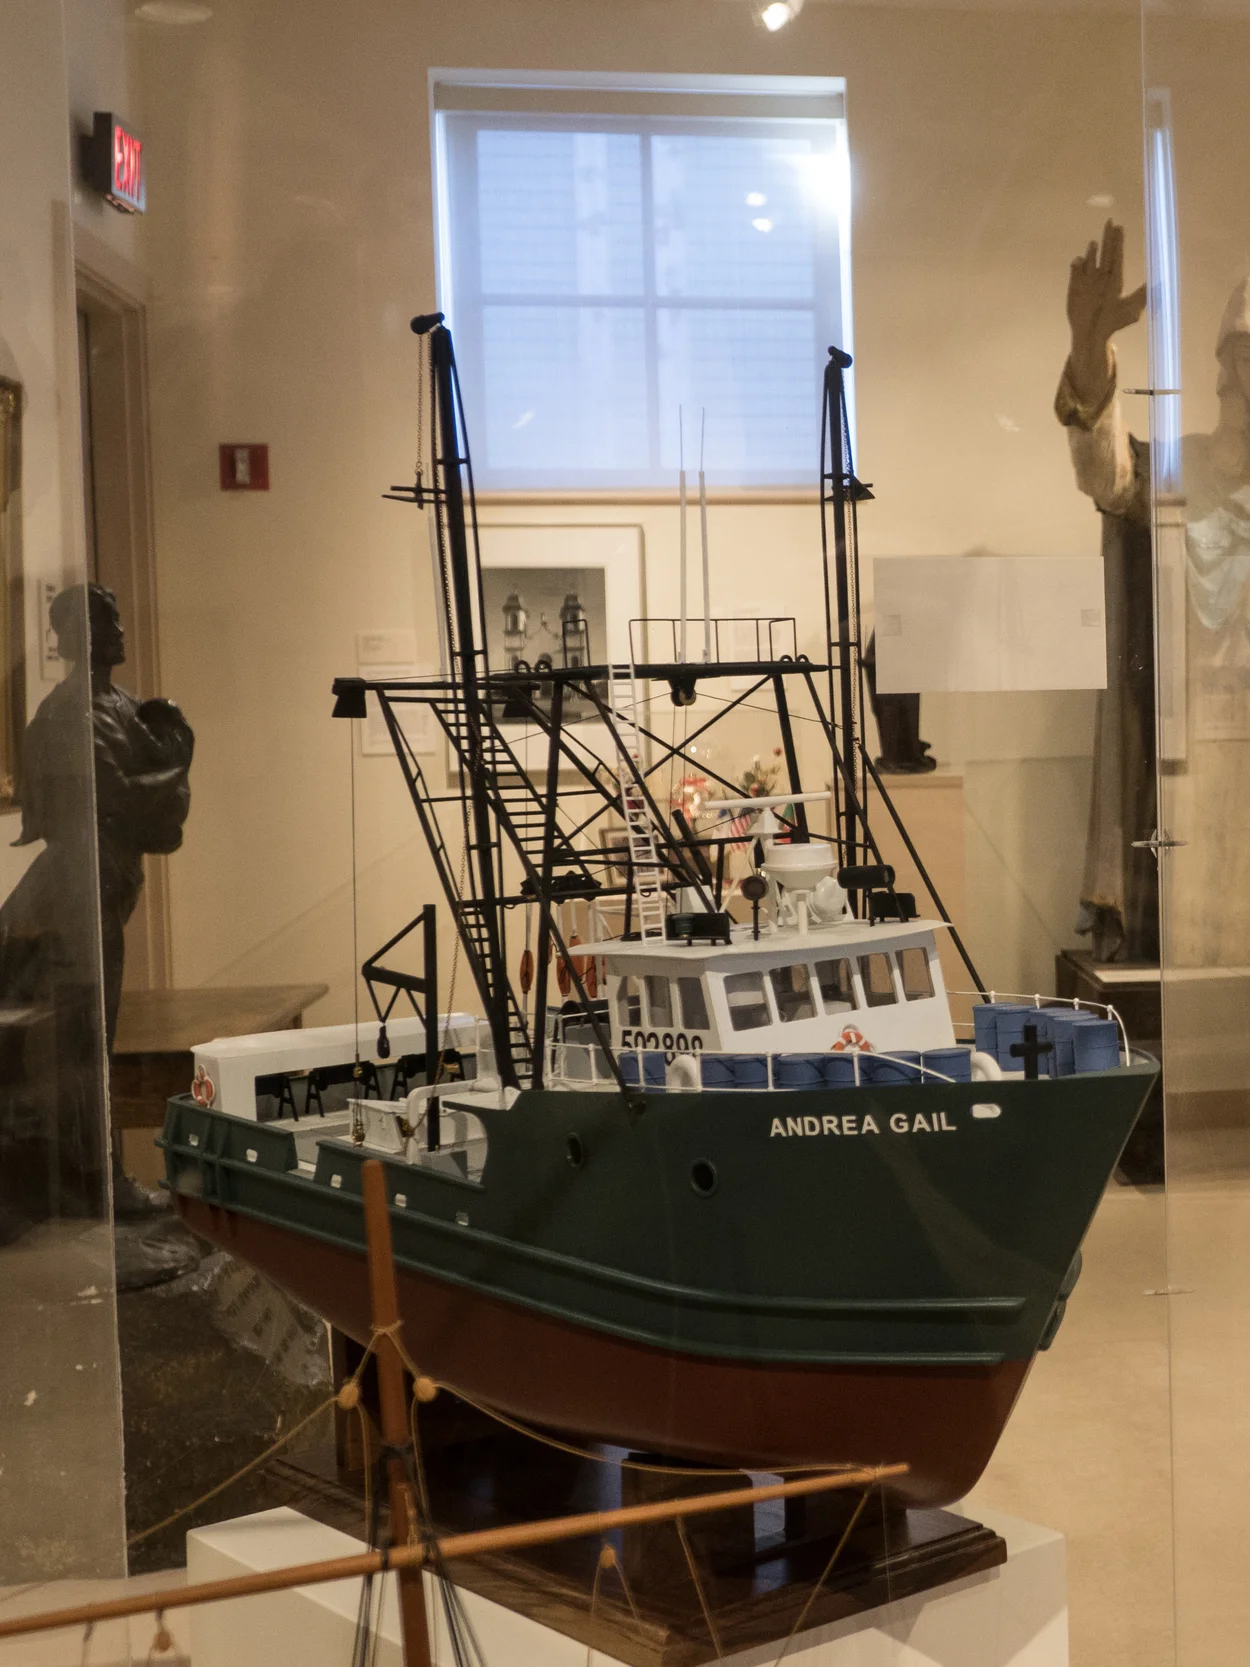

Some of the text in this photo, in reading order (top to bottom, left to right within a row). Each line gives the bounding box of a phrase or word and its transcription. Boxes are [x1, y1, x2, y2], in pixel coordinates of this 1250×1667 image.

[114, 125, 142, 203] EXIT
[769, 1111, 957, 1137] ANDREA GAIL
